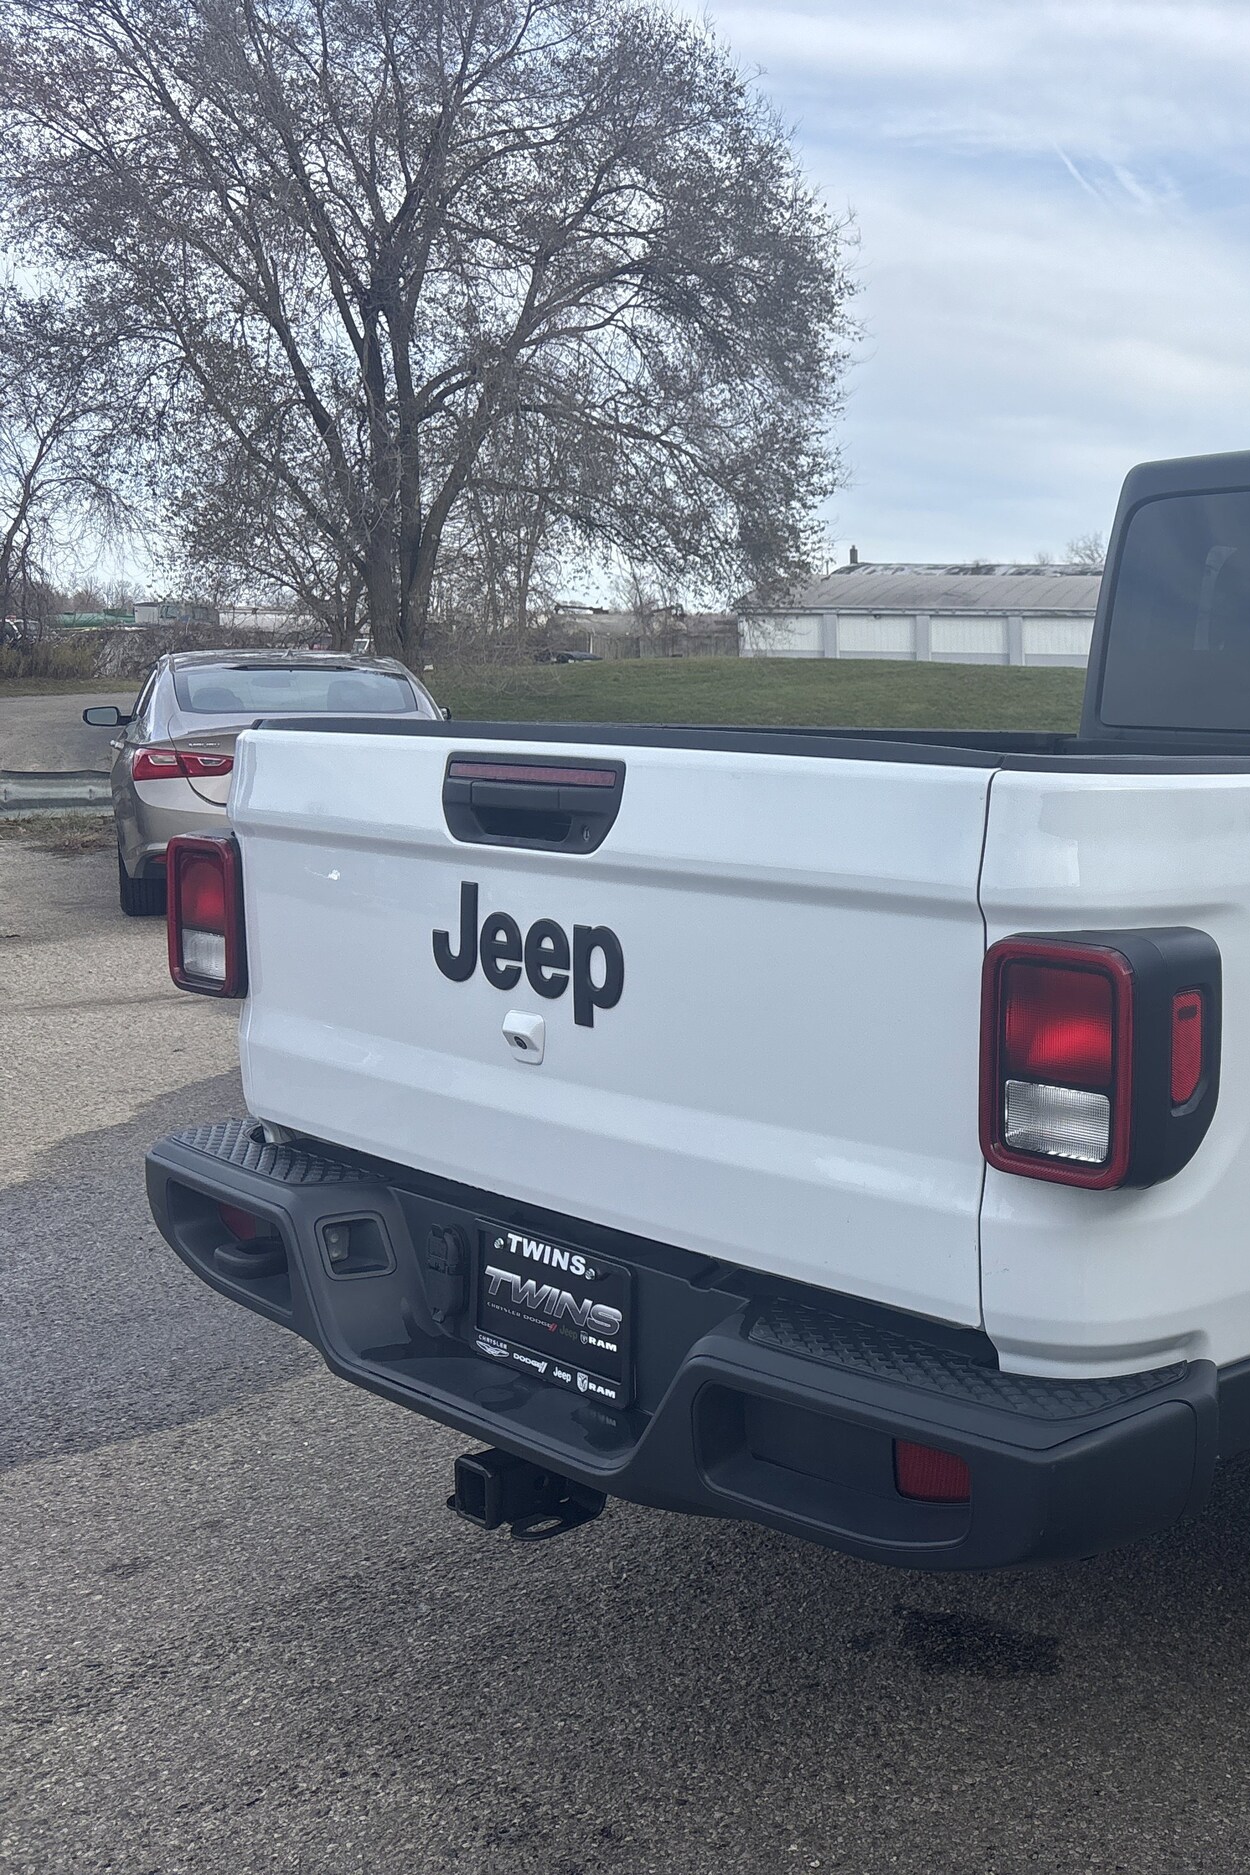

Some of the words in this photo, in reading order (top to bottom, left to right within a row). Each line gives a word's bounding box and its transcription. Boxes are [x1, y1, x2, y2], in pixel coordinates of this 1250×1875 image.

[432, 880, 625, 1028] Jeep
[507, 1233, 587, 1276] TWINS
[484, 1265, 623, 1336] TWINS
[478, 1334, 508, 1350] CHRYSLER
[486, 1301, 521, 1318] CHRYSLER
[559, 1324, 578, 1340] Jeep
[588, 1335, 618, 1352] RAM
[513, 1352, 545, 1372] DODGE
[552, 1366, 572, 1383] Jeep
[588, 1383, 616, 1399] RAM
